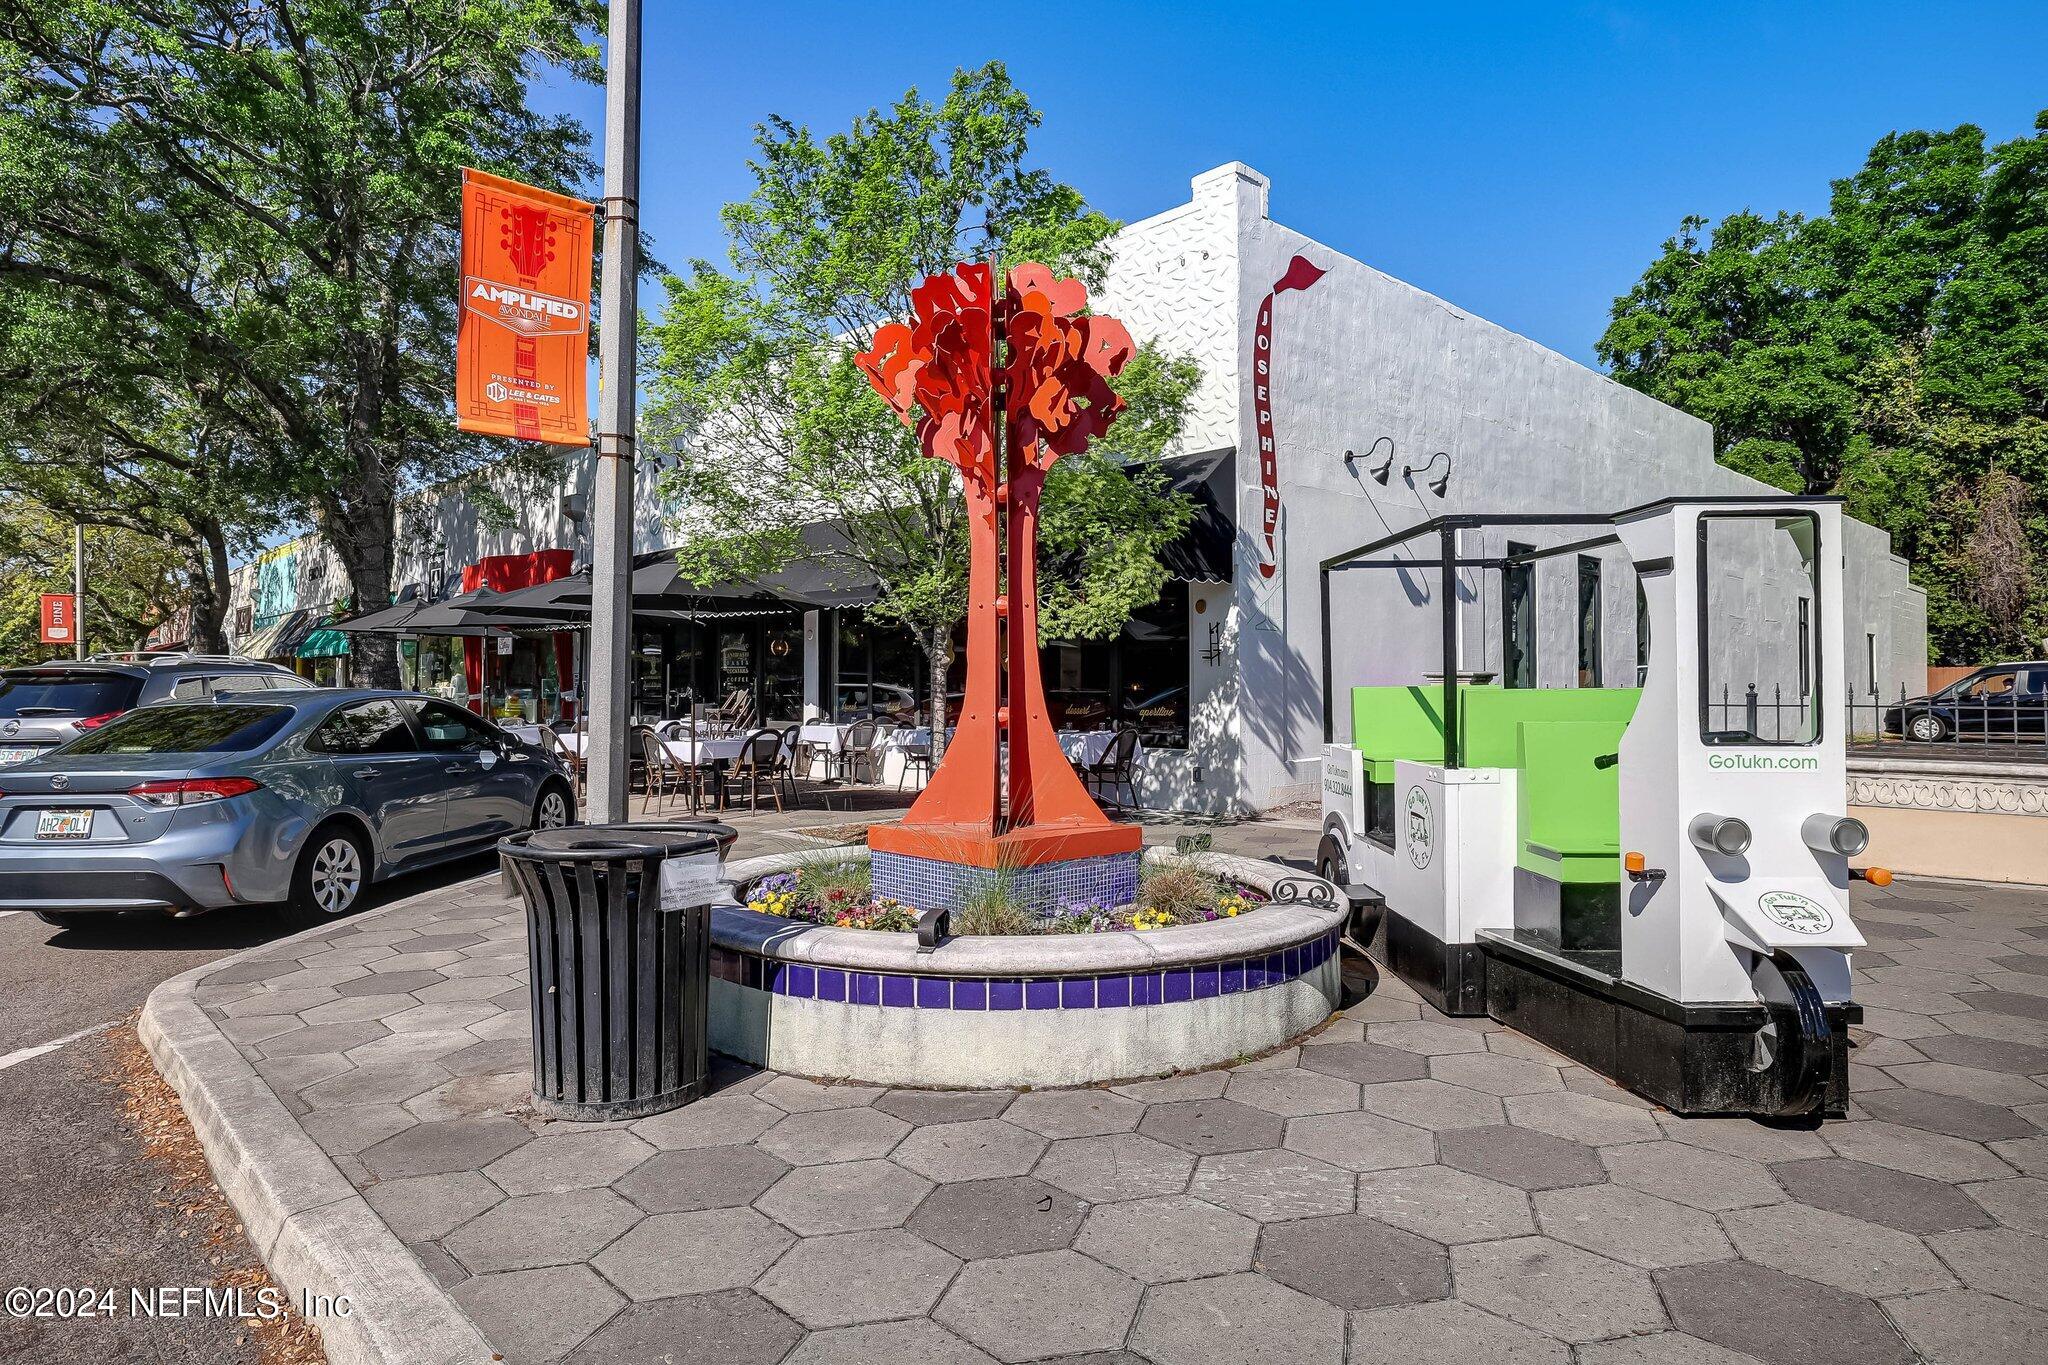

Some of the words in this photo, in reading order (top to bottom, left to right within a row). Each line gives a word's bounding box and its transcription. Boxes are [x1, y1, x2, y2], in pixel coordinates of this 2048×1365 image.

[472, 284, 578, 319] AMPLIFIED
[499, 304, 552, 322] AVONDALE
[491, 373, 541, 388] PRESENTED
[509, 389, 525, 398] LEE
[533, 393, 560, 404] CATES
[1256, 310, 1278, 524] JOSEPHINE
[53, 601, 63, 625] DINE
[1066, 704, 1091, 715] dessert
[1709, 754, 1818, 769] GoTukn.com
[1764, 896, 1777, 904] Go
[1776, 893, 1808, 906] Tuk'n
[1813, 922, 1827, 931] FL
